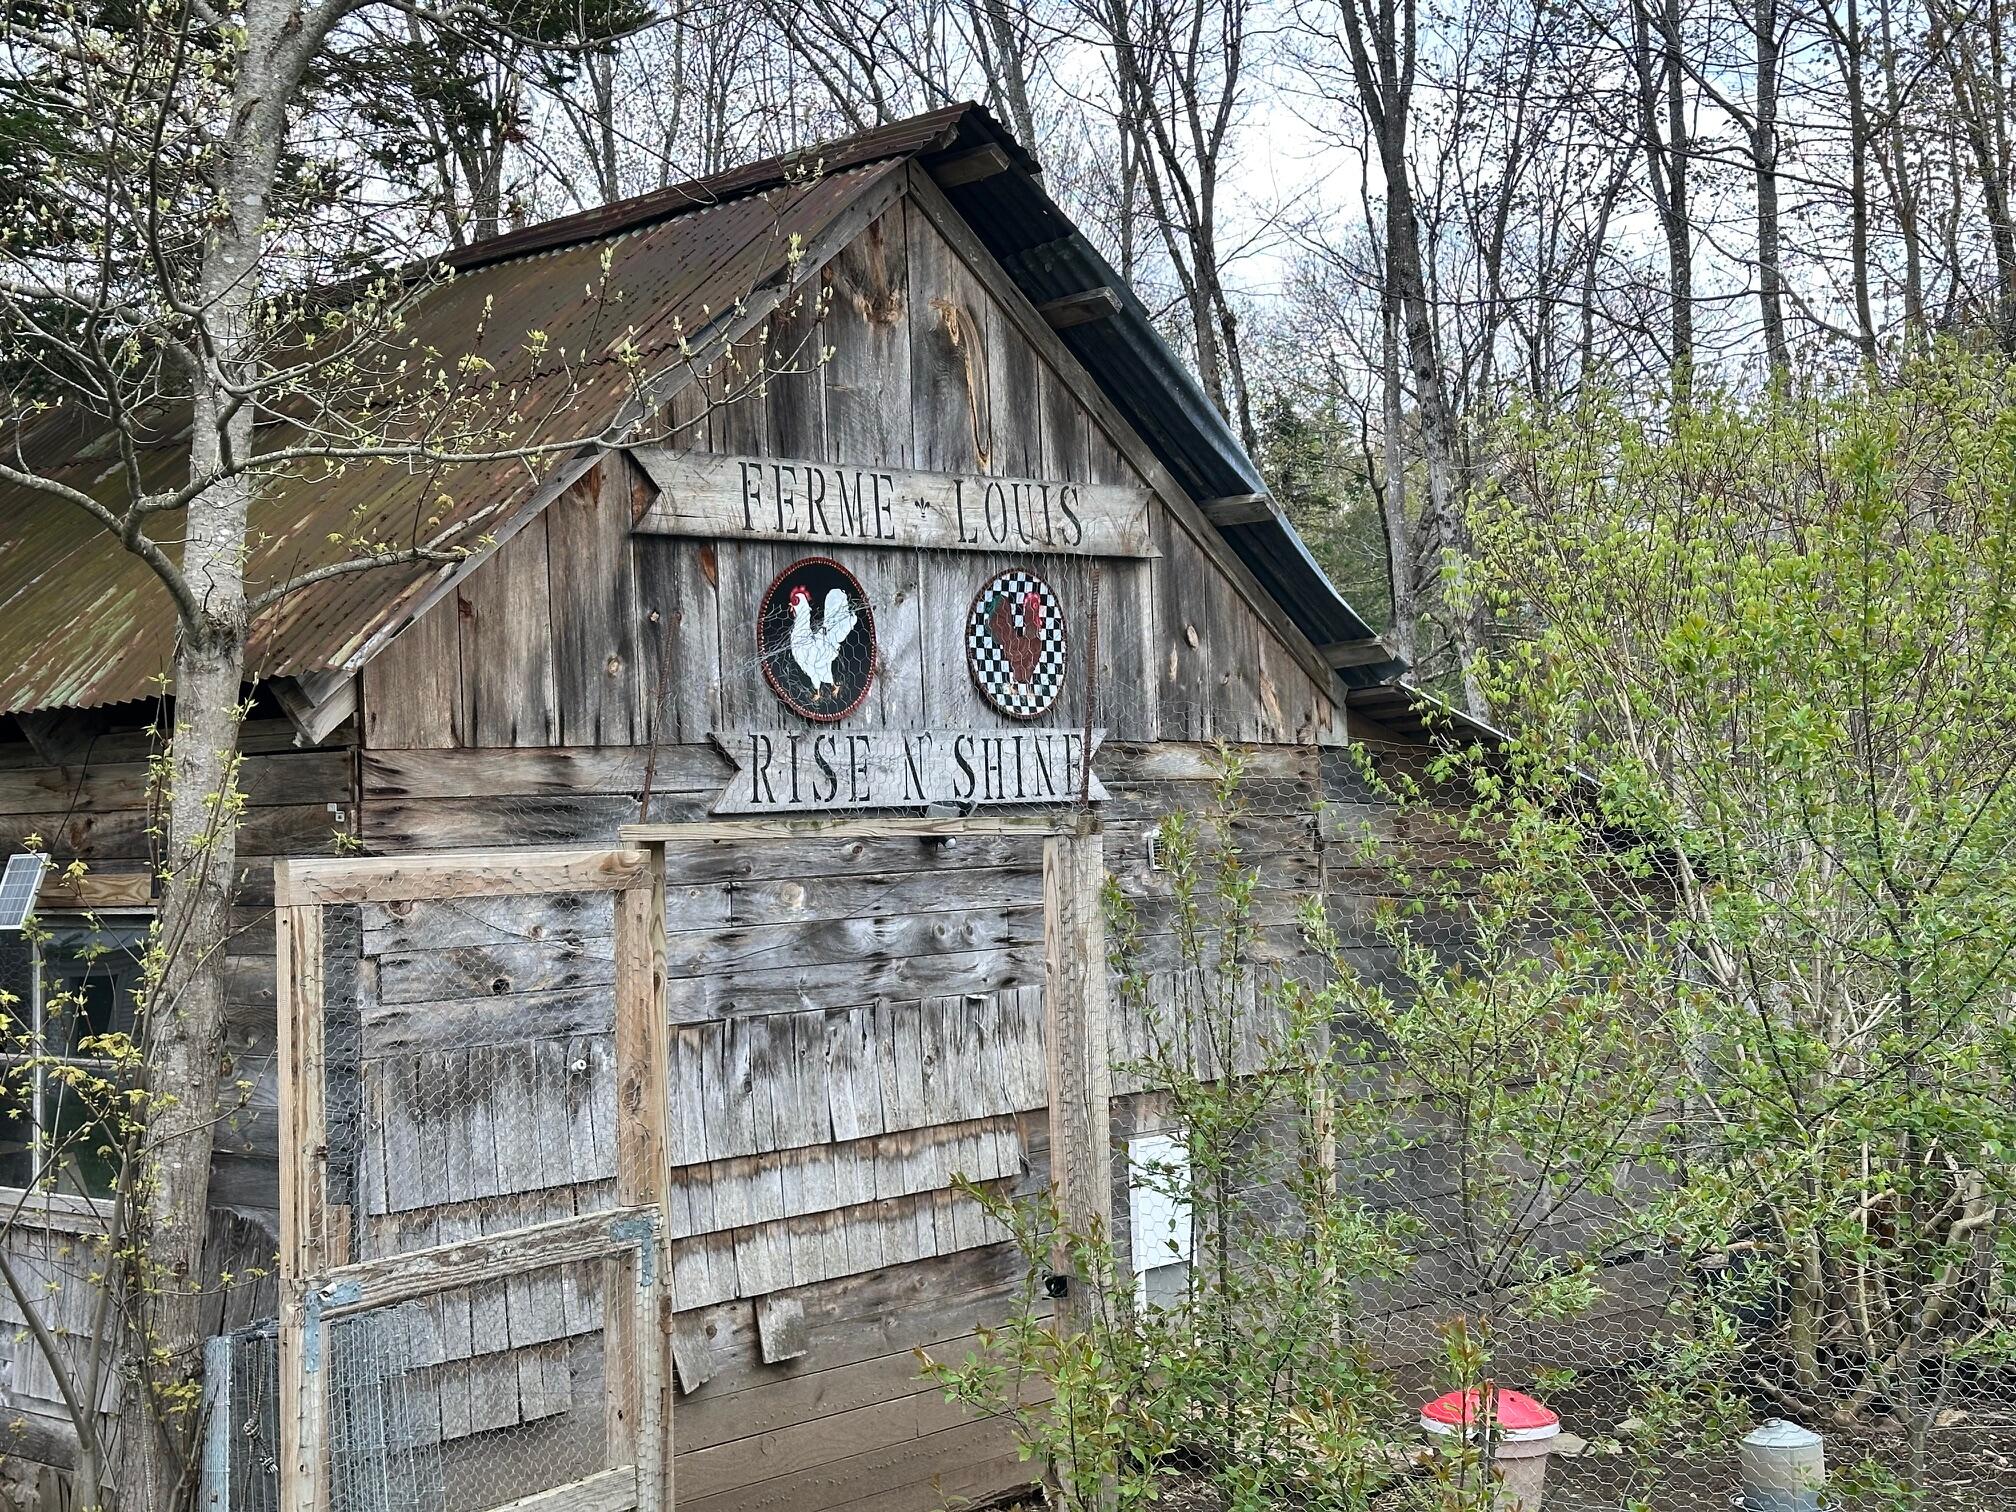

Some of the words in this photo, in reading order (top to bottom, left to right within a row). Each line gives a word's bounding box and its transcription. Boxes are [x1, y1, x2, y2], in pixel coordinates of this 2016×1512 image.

[738, 461, 896, 540] FERME
[952, 478, 1083, 546] LOUIS
[748, 733, 872, 803] RISE
[953, 733, 1085, 799] SHINE
